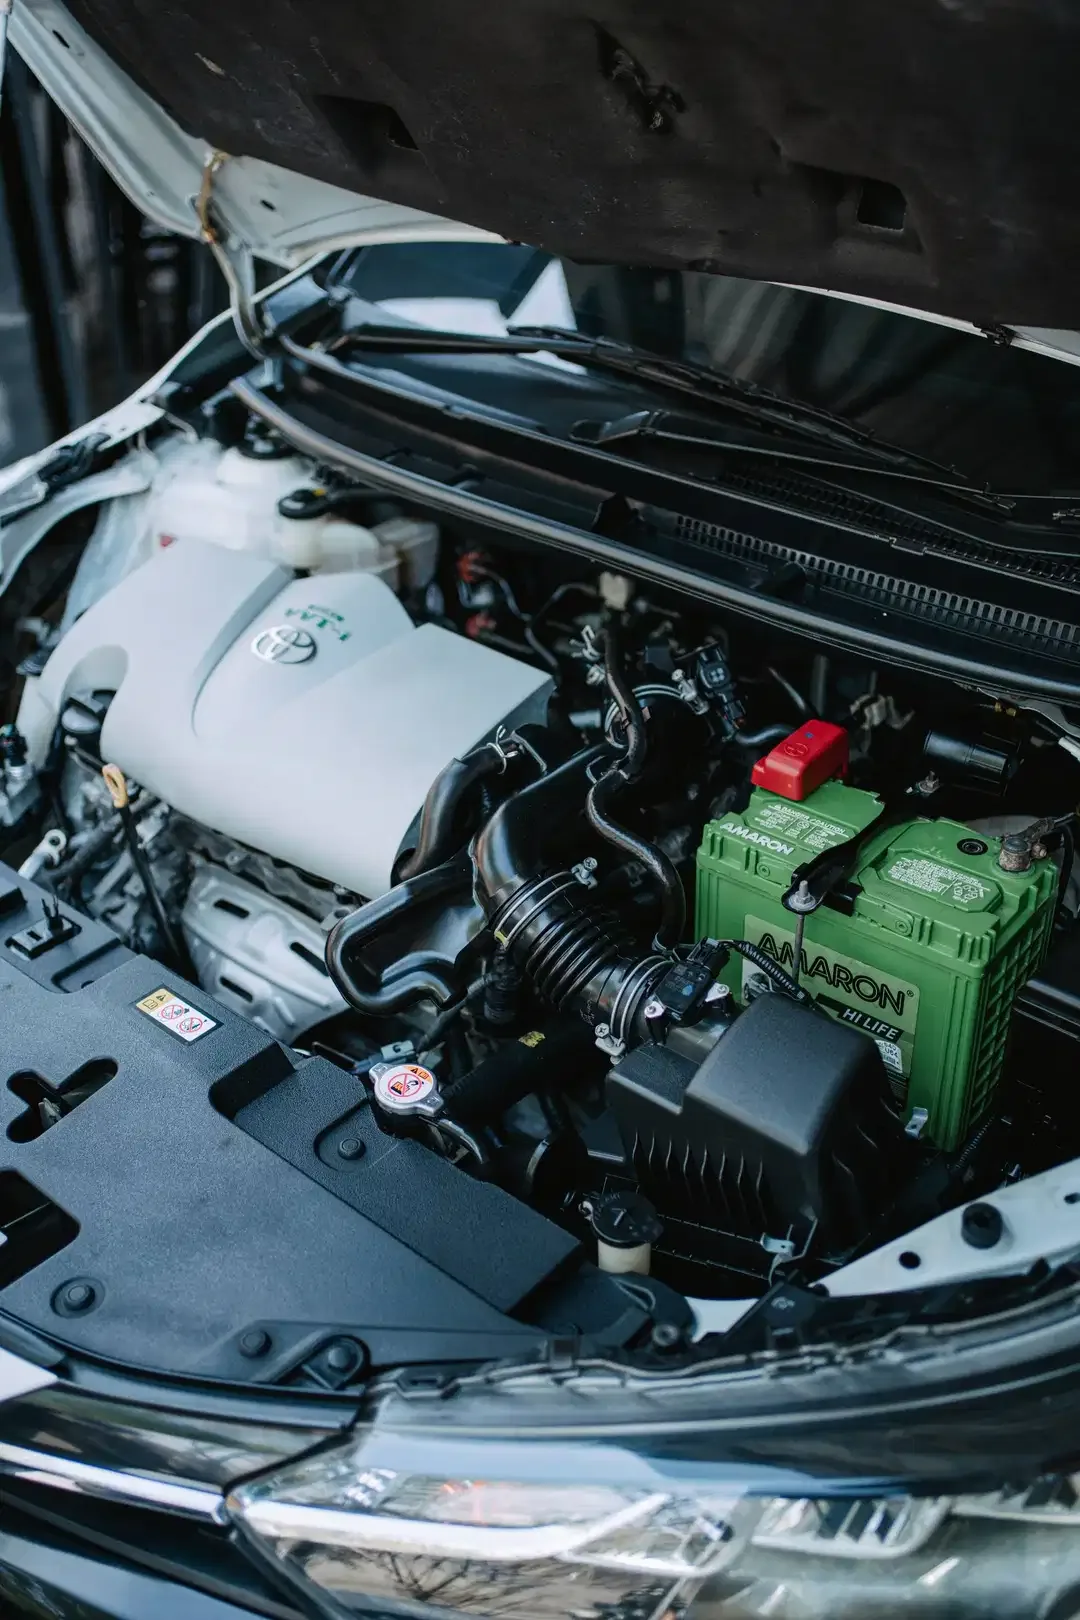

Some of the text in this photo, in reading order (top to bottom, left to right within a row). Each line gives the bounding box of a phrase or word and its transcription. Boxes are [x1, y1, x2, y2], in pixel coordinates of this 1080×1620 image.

[720, 822, 795, 856] AMARON
[757, 933, 905, 1016] AMARON
[842, 1008, 899, 1040] HI LIFE
